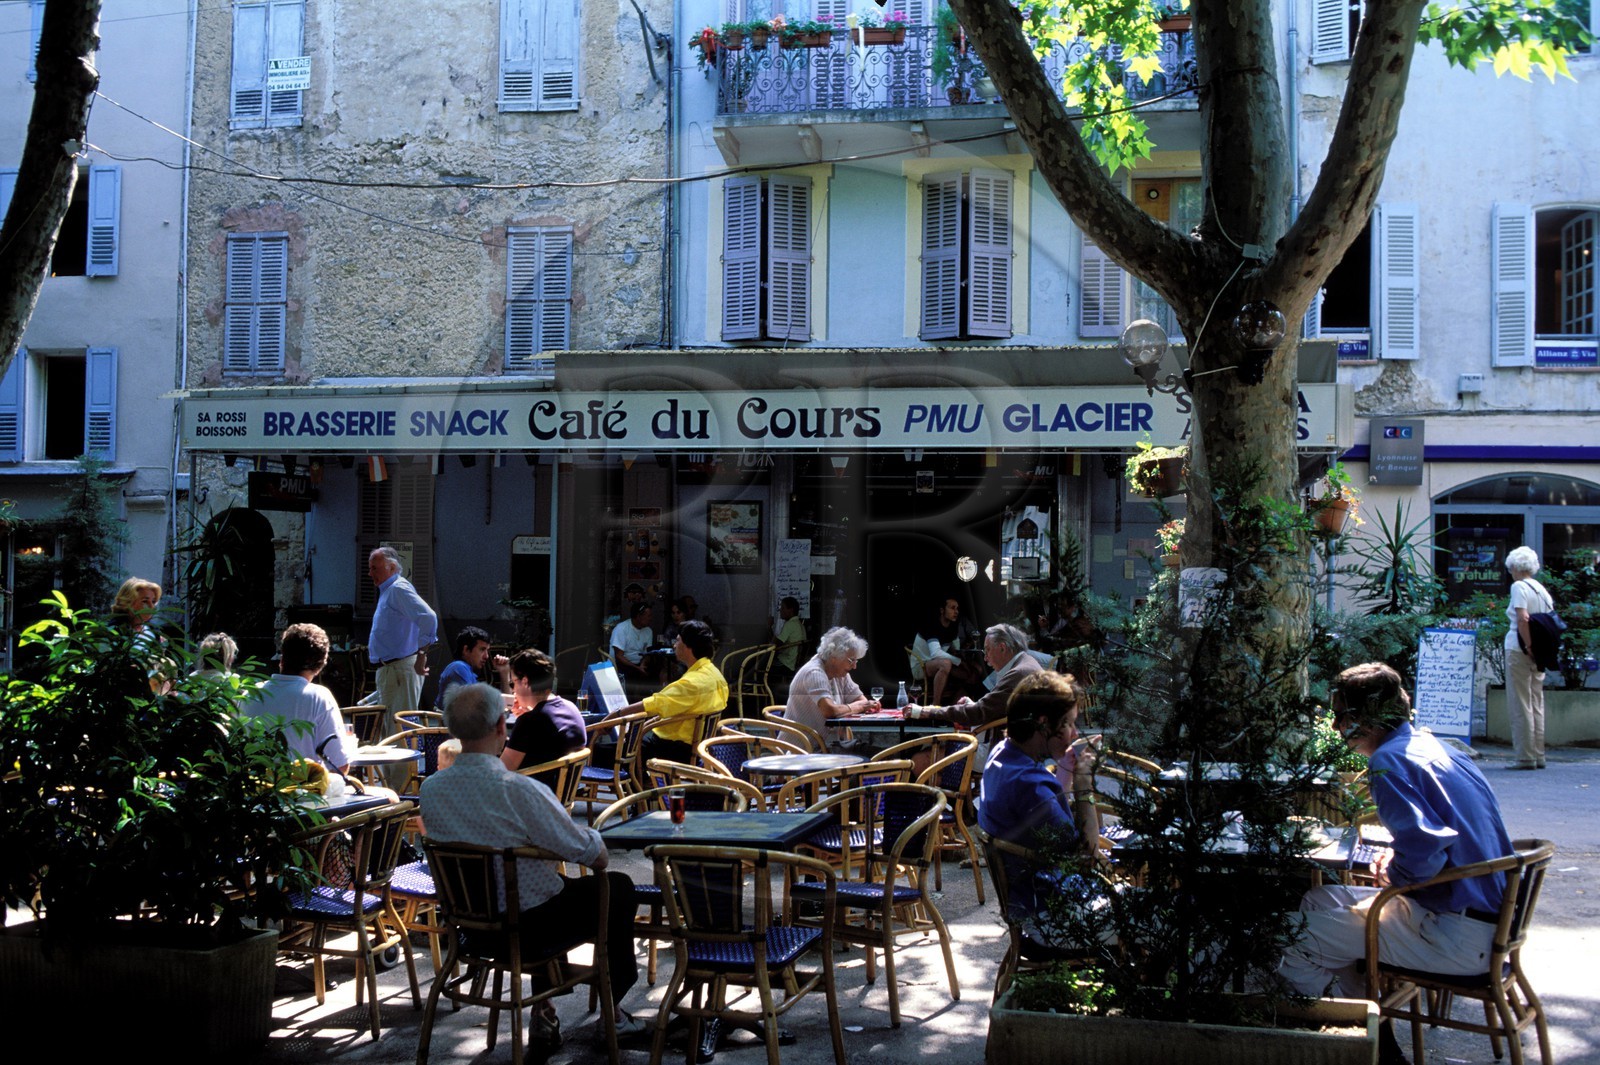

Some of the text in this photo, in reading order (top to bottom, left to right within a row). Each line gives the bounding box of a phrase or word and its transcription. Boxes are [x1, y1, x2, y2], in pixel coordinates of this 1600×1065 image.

[270, 58, 310, 69] A VENDRE
[1352, 343, 1367, 351] Via
[197, 411, 247, 423] SA ROSSI
[263, 410, 396, 437] BRASSERIE
[410, 409, 509, 437] SNACK
[528, 399, 627, 441] Café
[651, 398, 710, 439] du
[736, 396, 881, 439] Cours
[903, 403, 984, 433] PMU
[1002, 401, 1154, 432] GLACIER
[195, 426, 248, 437] BOISSONS
[1385, 427, 1411, 439] CIC
[1376, 454, 1418, 462] Lyonnaise
[1387, 464, 1418, 472] Banque
[278, 476, 307, 495] PMU
[1455, 569, 1501, 583] gratuite
